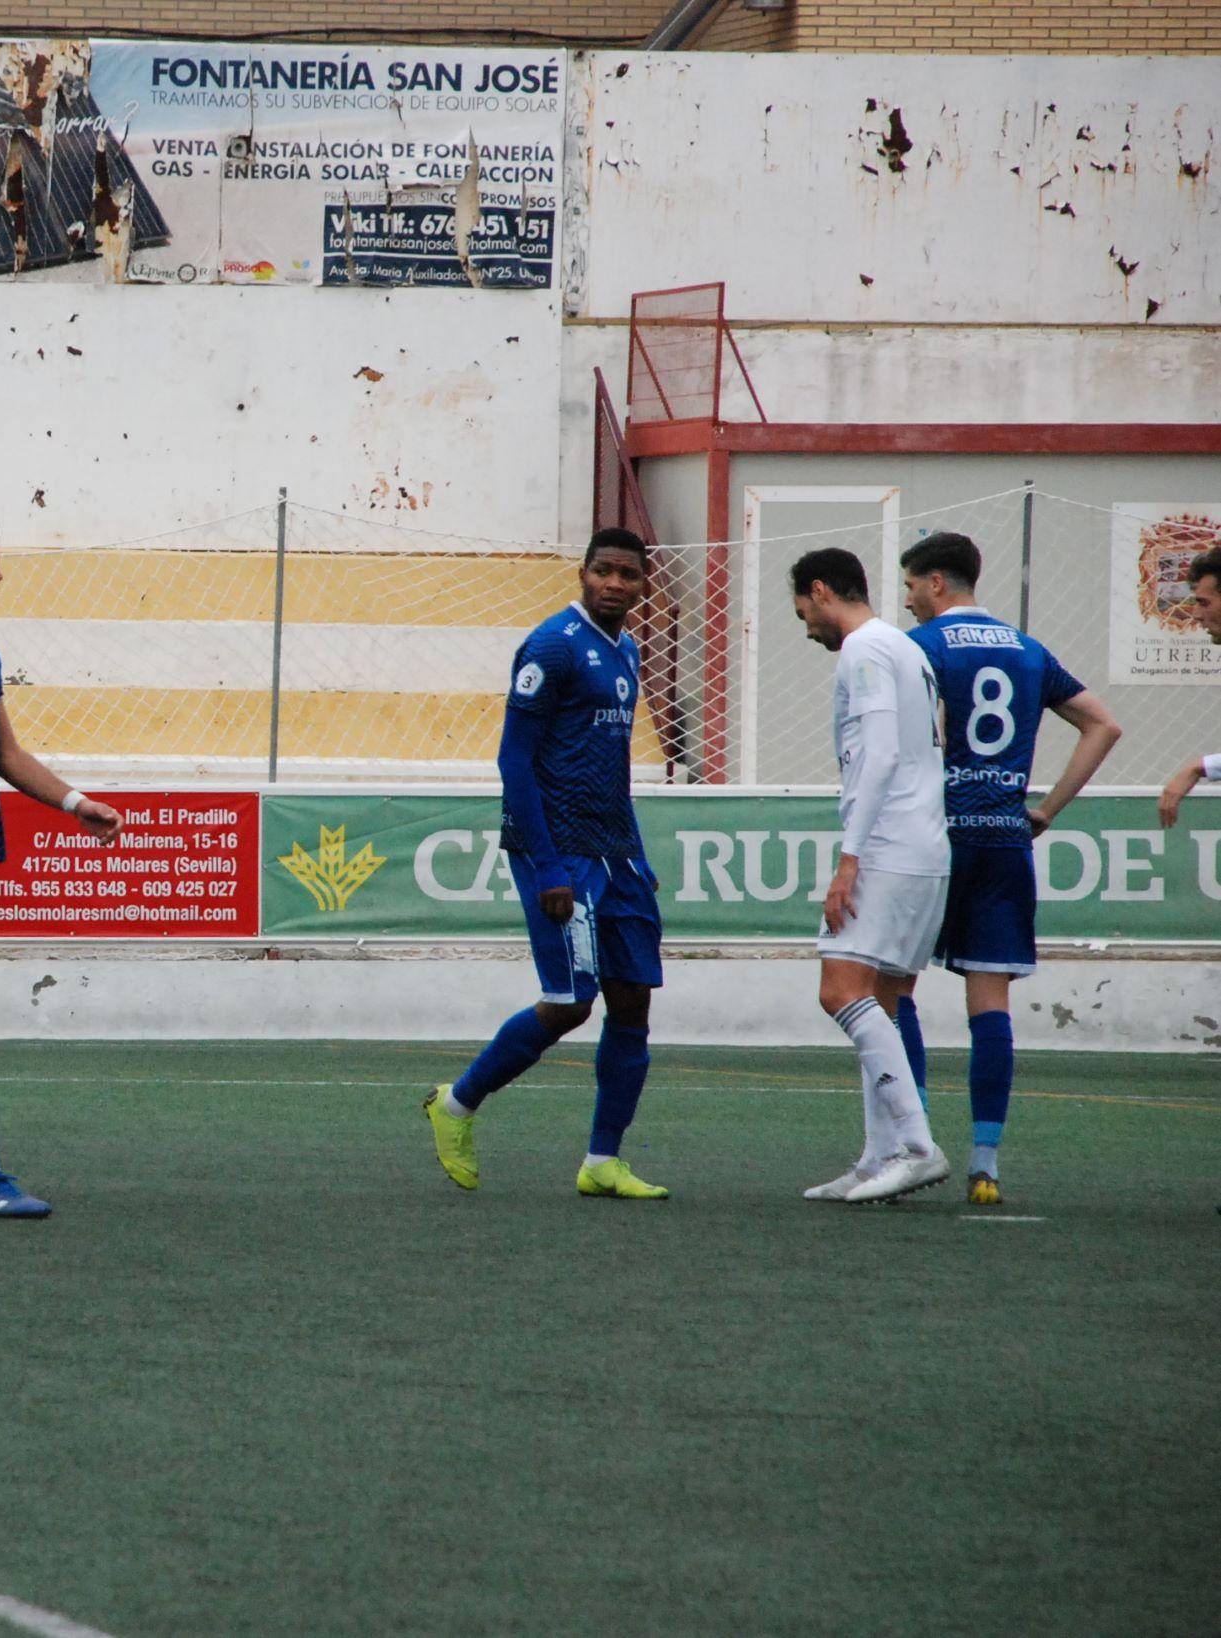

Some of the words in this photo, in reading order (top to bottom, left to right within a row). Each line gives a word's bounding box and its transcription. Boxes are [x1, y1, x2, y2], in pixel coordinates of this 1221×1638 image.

[152, 53, 375, 91] FONTANERÍA
[387, 61, 462, 92] SAN
[474, 57, 559, 94] JOSÉ
[151, 90, 259, 109] TRAMITAMOS
[266, 93, 285, 109] SU
[410, 97, 430, 111] DE
[436, 96, 499, 112] EQUIPO
[506, 97, 557, 112] SOLAR
[153, 139, 218, 156] VENTA
[254, 139, 383, 159] NSTALACIÓN
[392, 143, 415, 158] DE
[424, 142, 555, 162] FONANERÍA
[152, 160, 193, 178] GAS
[224, 159, 311, 180] ENERGÍA
[321, 163, 390, 180] SOLAR
[1136, 647, 1221, 662] UTRER
[967, 666, 1015, 756] 8
[125, 808, 155, 825] Ind.
[159, 808, 173, 825] El
[178, 808, 237, 825] Pradillo
[33, 832, 51, 849] C/
[120, 832, 188, 851] Mairena,
[193, 833, 238, 849] 15-16
[22, 857, 70, 873] 41750
[74, 857, 101, 873] Los
[107, 857, 169, 873] Molares
[174, 856, 237, 876] (Sevilla)
[31, 881, 59, 897] 955
[64, 881, 93, 897] 833
[97, 881, 126, 897] 648
[142, 881, 171, 897] 609
[175, 881, 204, 897] 425
[208, 881, 237, 897] 027
